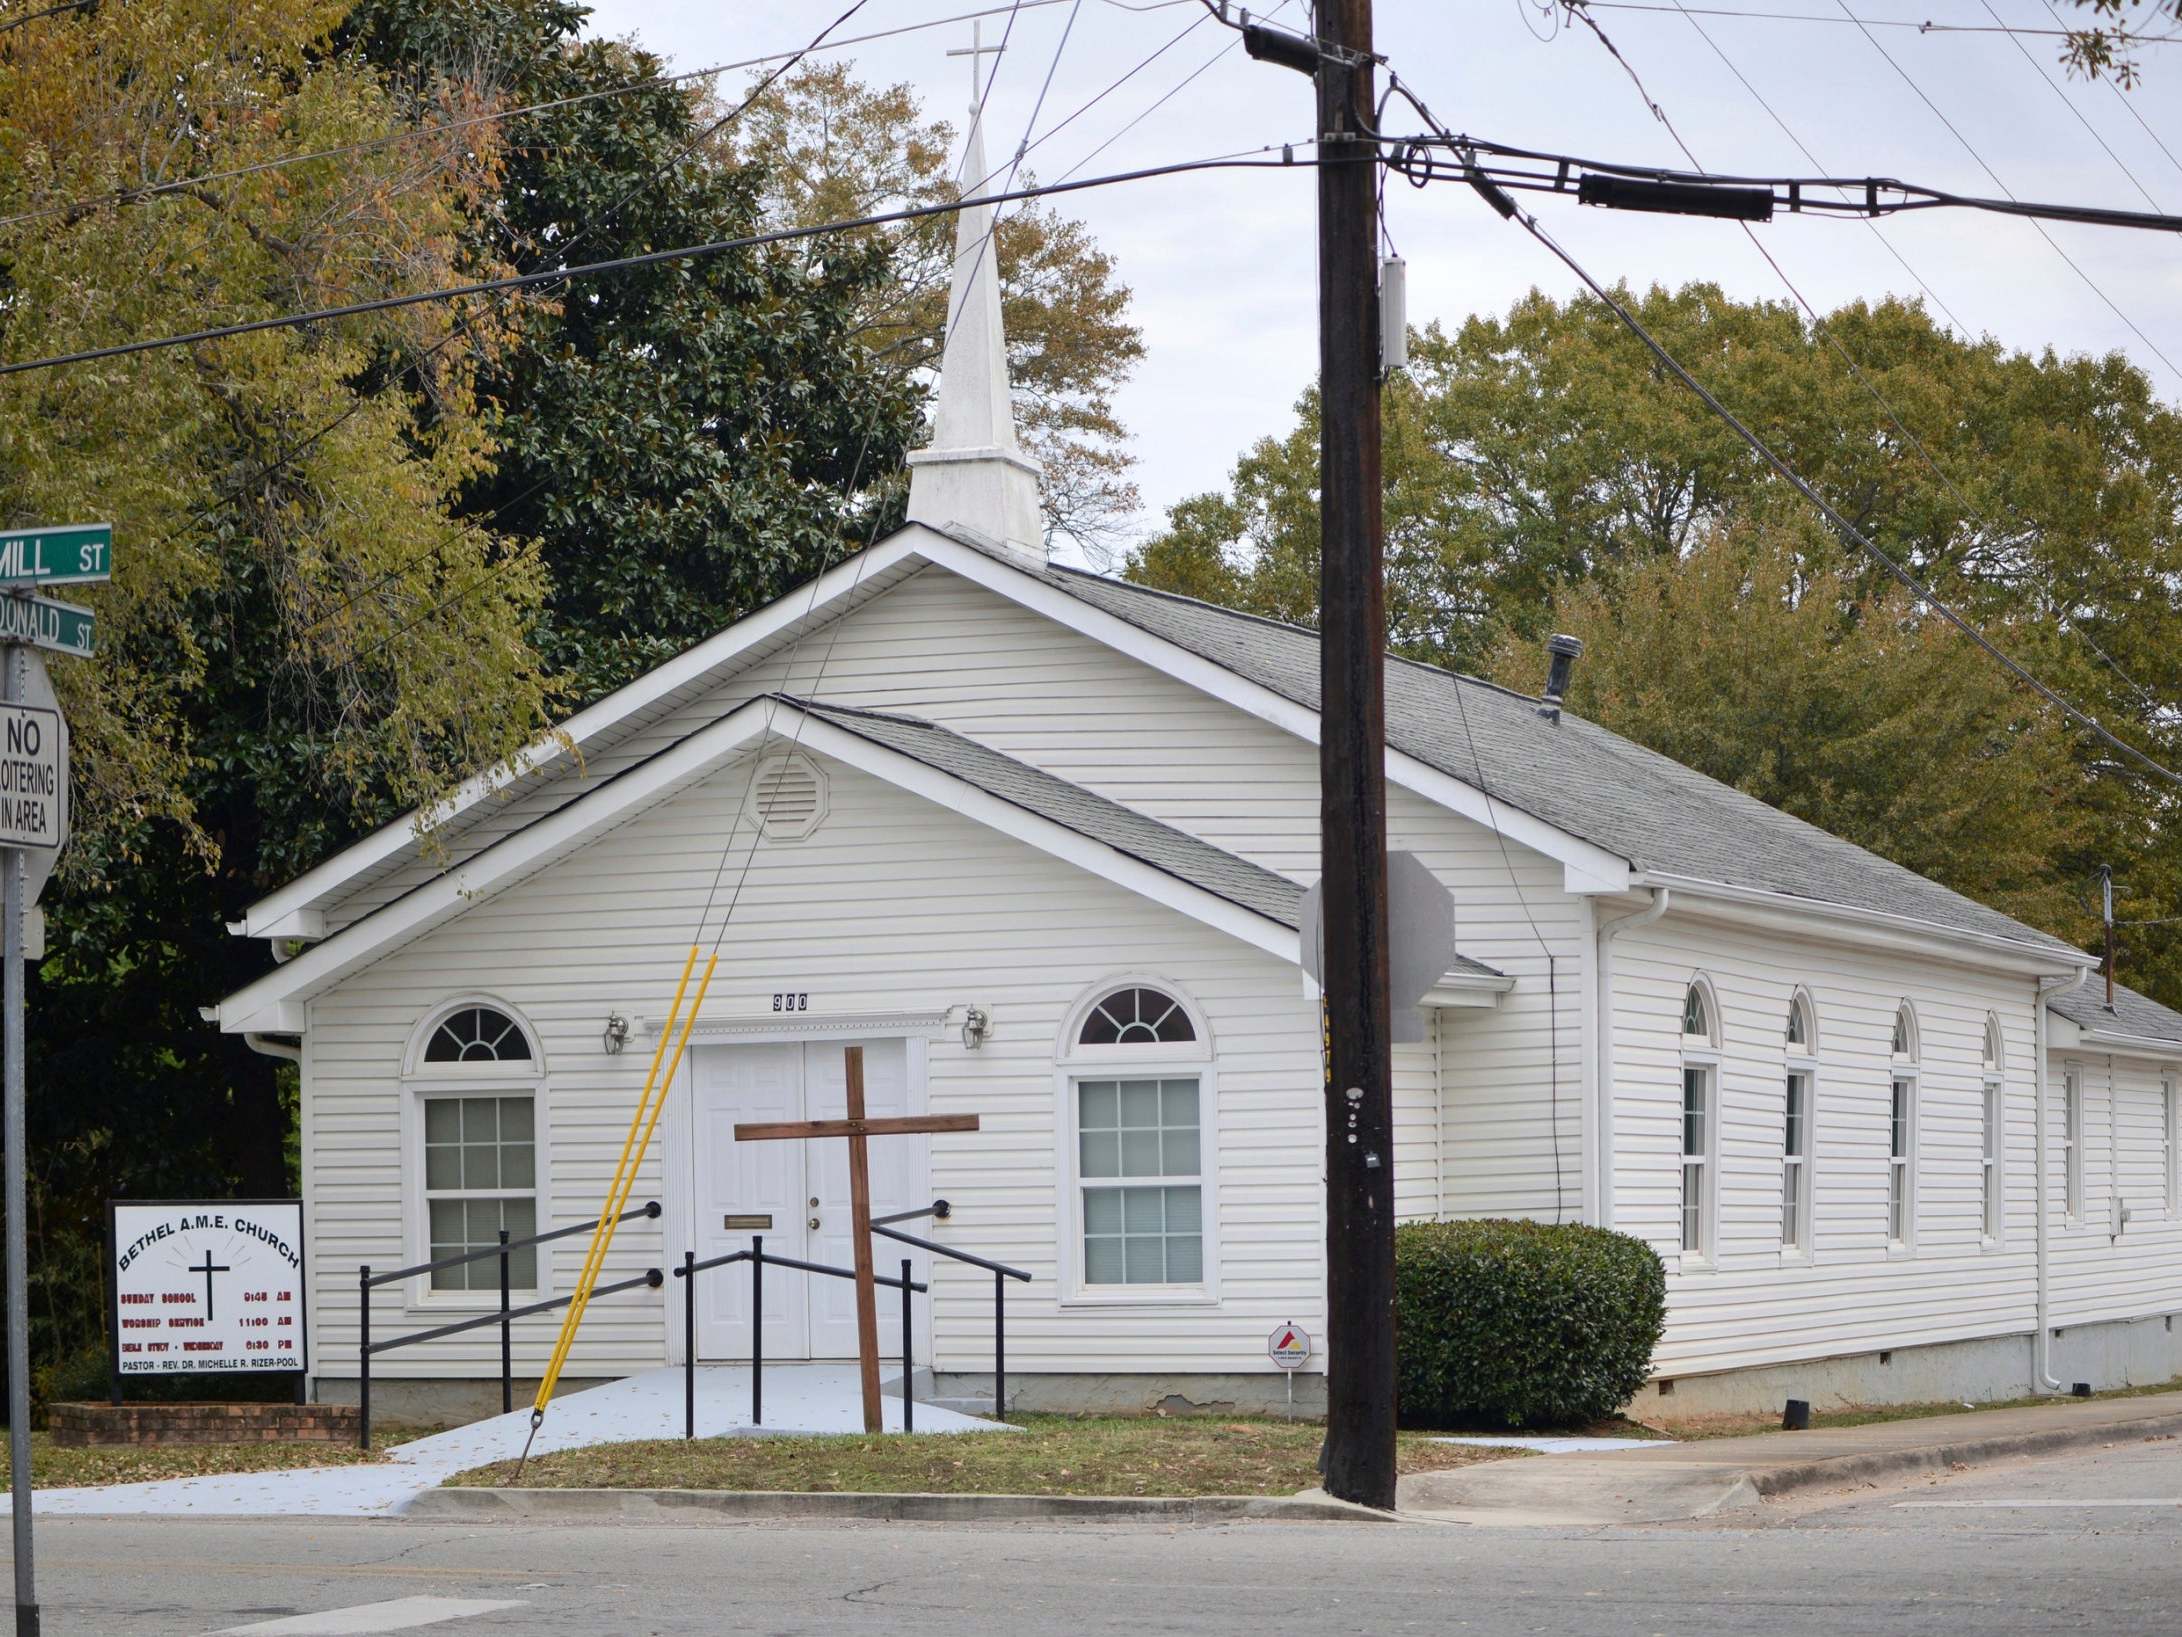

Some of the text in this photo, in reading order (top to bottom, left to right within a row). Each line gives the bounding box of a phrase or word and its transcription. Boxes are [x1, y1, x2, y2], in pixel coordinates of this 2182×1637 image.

[79, 543, 105, 572] ST
[76, 623, 92, 652] ST
[7, 717, 41, 756] NO
[0, 758, 54, 796] OITERING
[1, 796, 47, 834] IN AREA
[773, 994, 807, 1011] 900
[118, 1215, 300, 1273] BETHEL A.M.E. CHURCH
[239, 1317, 269, 1327] 11:00
[122, 1361, 155, 1371] PASTOR
[162, 1361, 180, 1370] REV.
[182, 1360, 196, 1369] DR.
[198, 1359, 238, 1369] MICHELLE
[240, 1359, 249, 1368] R.
[251, 1357, 299, 1368] RIZER-POOL
